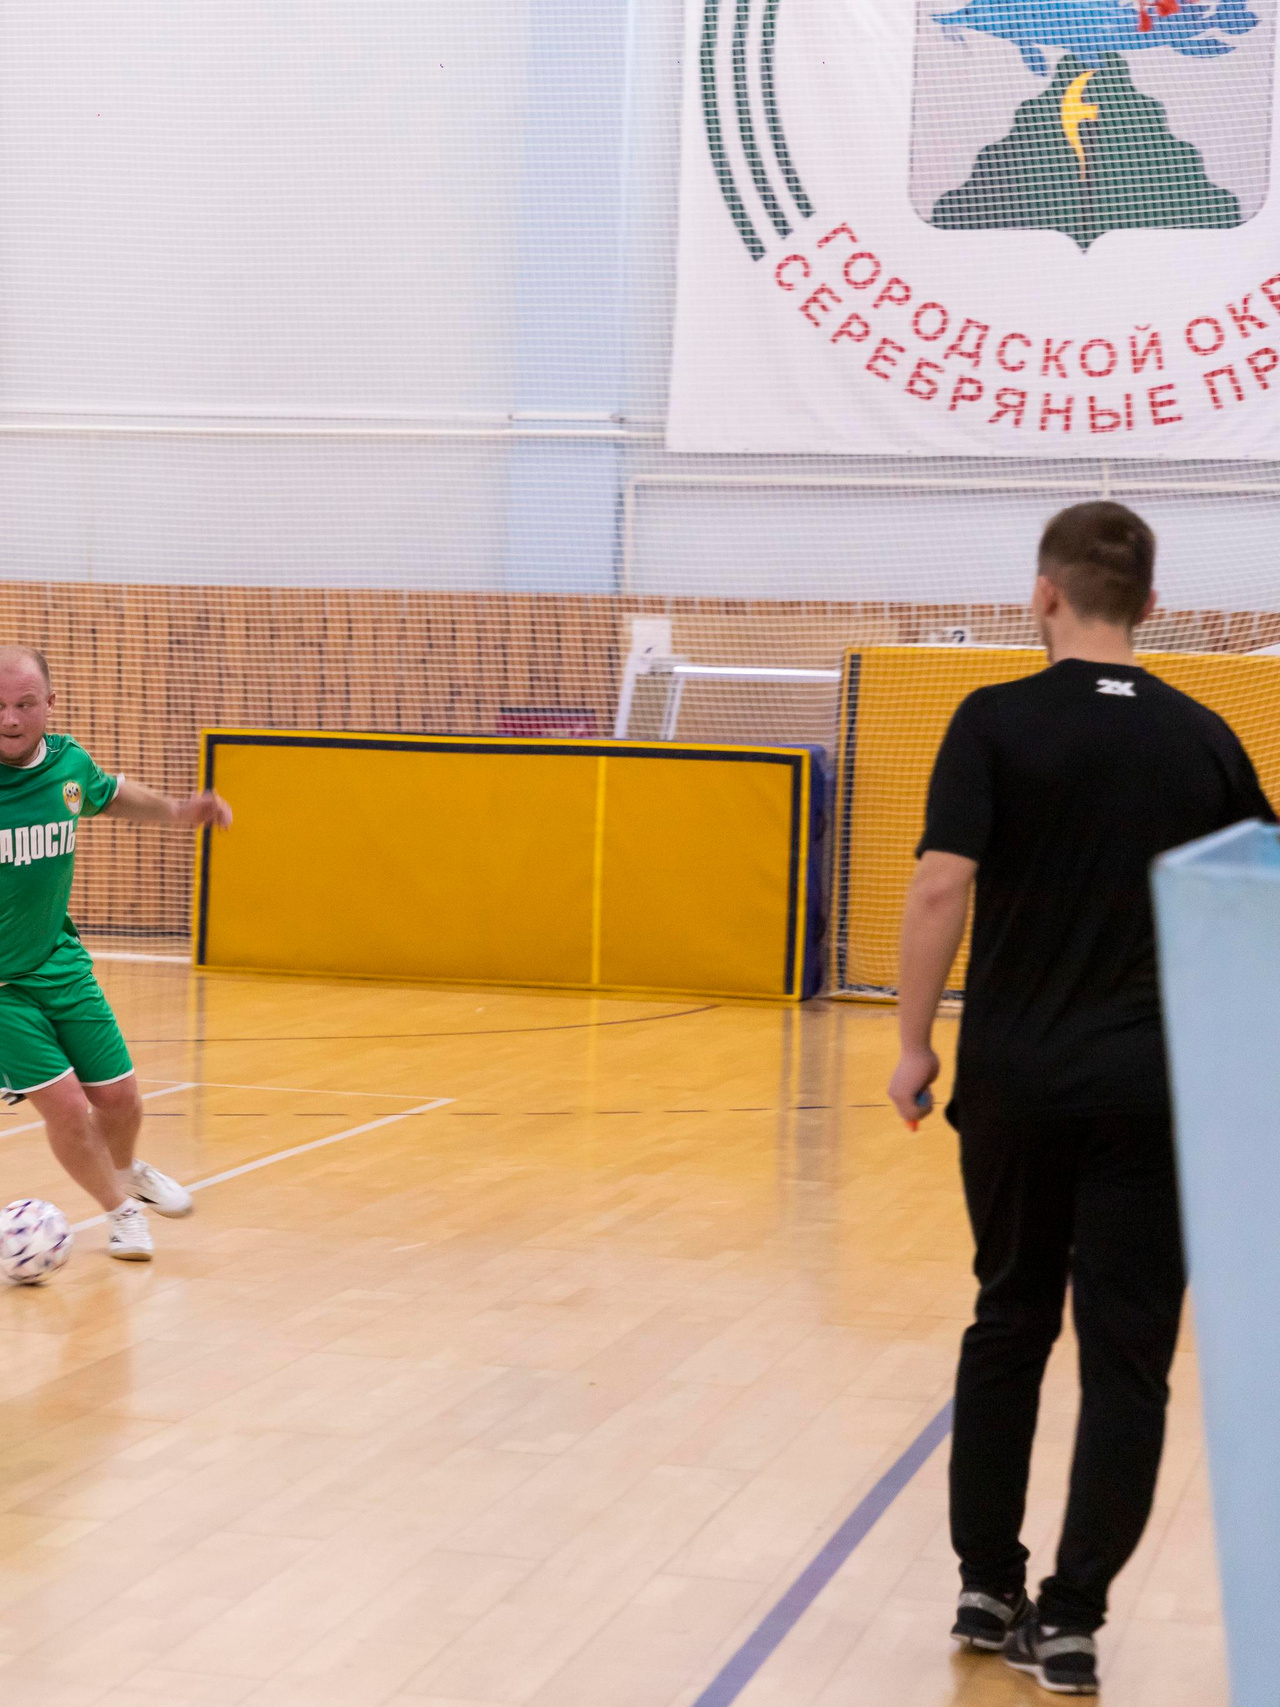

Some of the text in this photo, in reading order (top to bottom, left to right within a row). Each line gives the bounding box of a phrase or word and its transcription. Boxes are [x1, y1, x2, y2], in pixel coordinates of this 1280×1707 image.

[775, 254, 1279, 433] СЕРЕБРЯНЫЕ ПР
[817, 223, 1165, 378] ГОРОДСКОЙ
